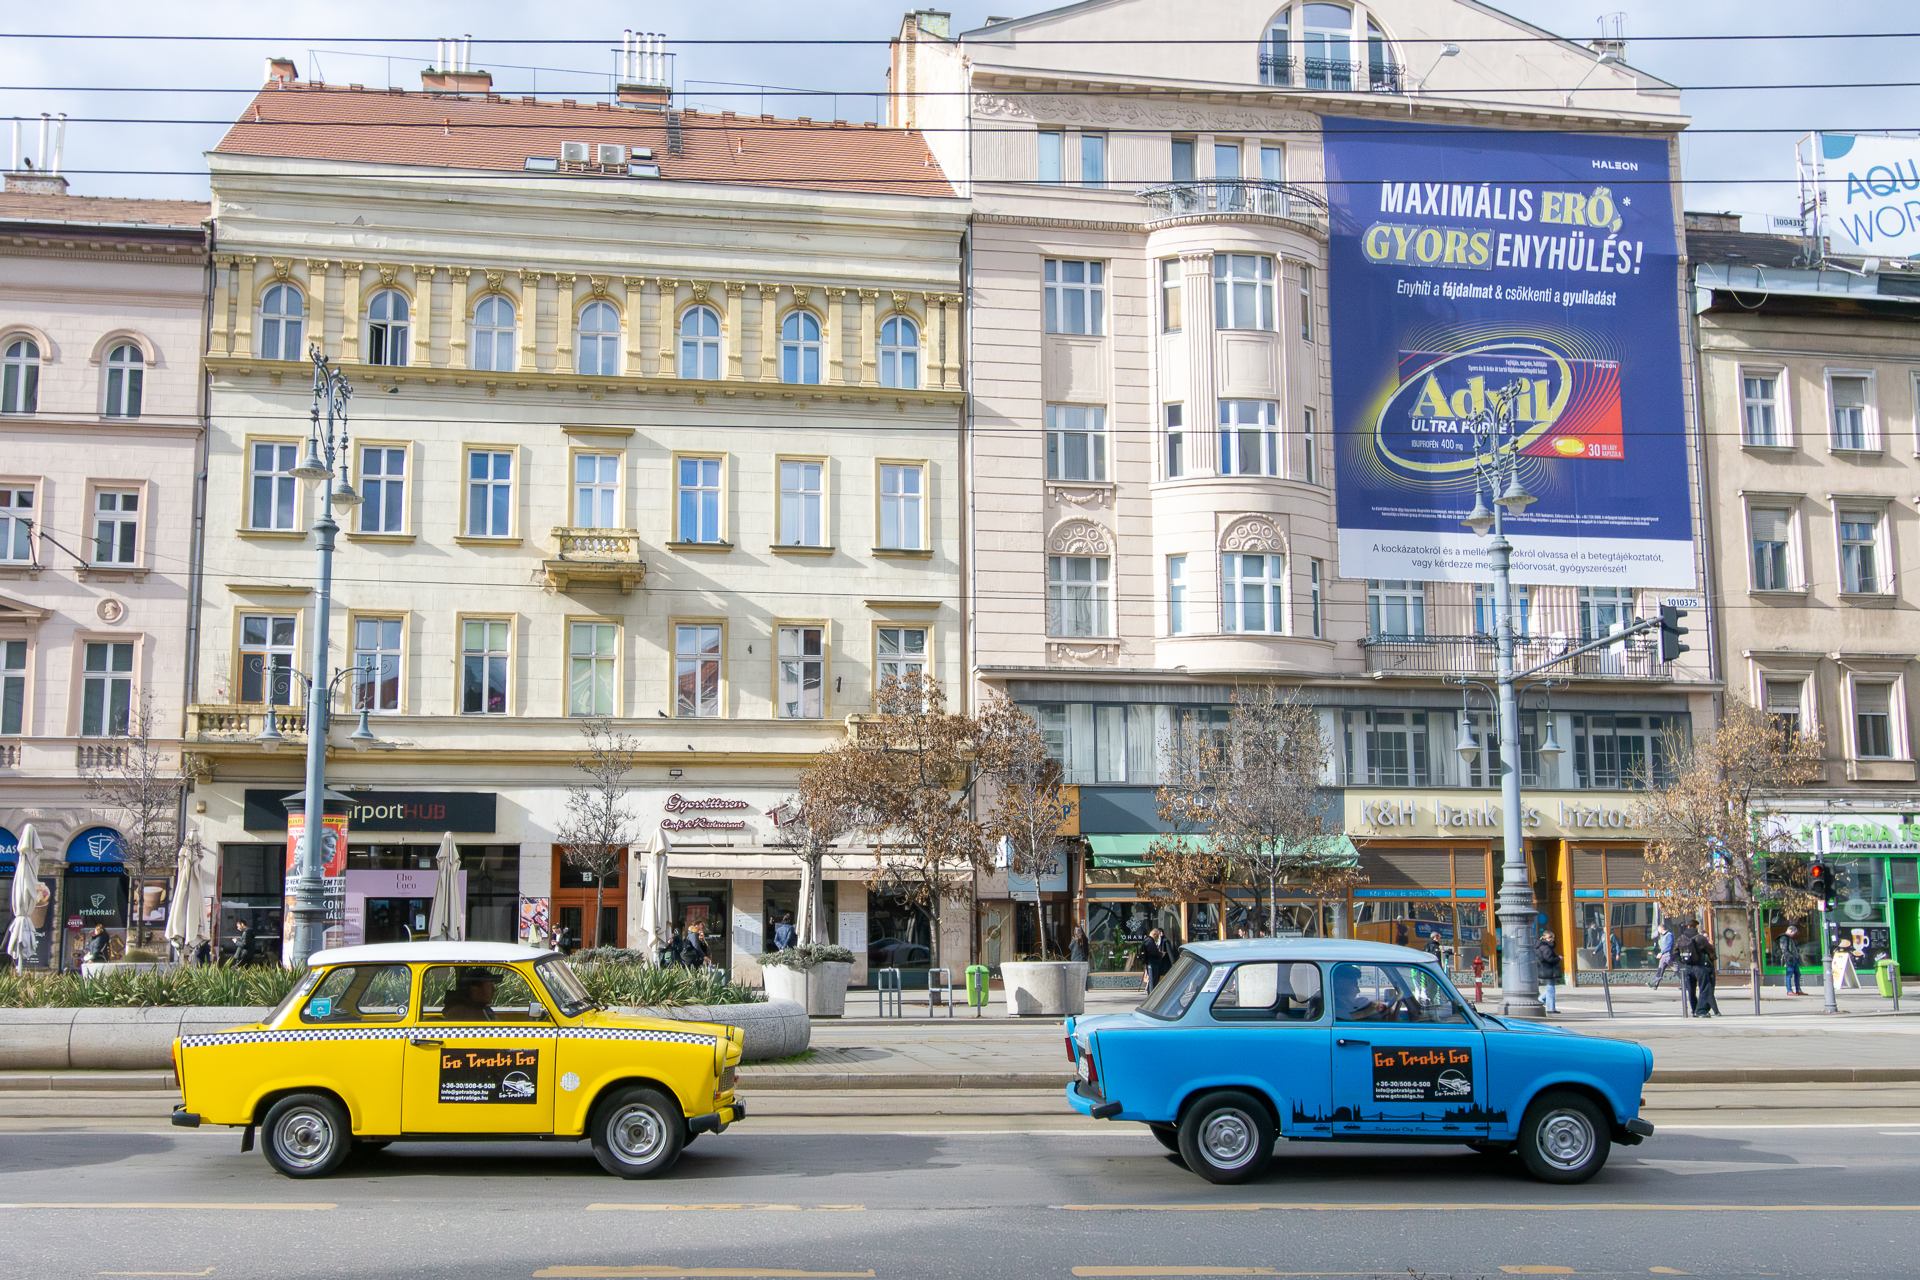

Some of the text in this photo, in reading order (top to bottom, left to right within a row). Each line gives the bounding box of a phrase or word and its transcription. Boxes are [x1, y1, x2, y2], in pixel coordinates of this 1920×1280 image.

[1592, 160, 1638, 171] HALEON
[1380, 180, 1533, 222] MAXIMÁLIS
[1776, 218, 1805, 227] 1004312
[1366, 225, 1643, 274] GYORS ENYHÜLÉS!
[1397, 279, 1617, 307] Enyhíti a fájdalmat & csökkenti a gyulladást
[1412, 372, 1554, 422] Advil
[1411, 419, 1457, 434] ULTRA
[1441, 439, 1454, 449] 400
[1455, 443, 1463, 451] mg
[1588, 443, 1600, 456] 30
[1372, 544, 1380, 552] A
[1381, 543, 1441, 555] kockázatokról
[1443, 547, 1452, 555] és
[1537, 551, 1568, 559] olvassa
[1570, 551, 1578, 559] el
[1587, 551, 1664, 563] betegtájékoztatót,
[1412, 560, 1432, 569] vagy
[1434, 559, 1473, 569] kérdezze
[1559, 564, 1627, 574] gyógyszerészét!
[1667, 598, 1697, 606] 1010375
[1360, 799, 1417, 827] K&H
[1435, 799, 1497, 827] bank
[1801, 823, 1892, 842] MTCHA
[73, 865, 123, 873] GREEN FOOD
[442, 1051, 536, 1069] Go Trabi Go
[1374, 1049, 1470, 1067] Go Trabi Go
